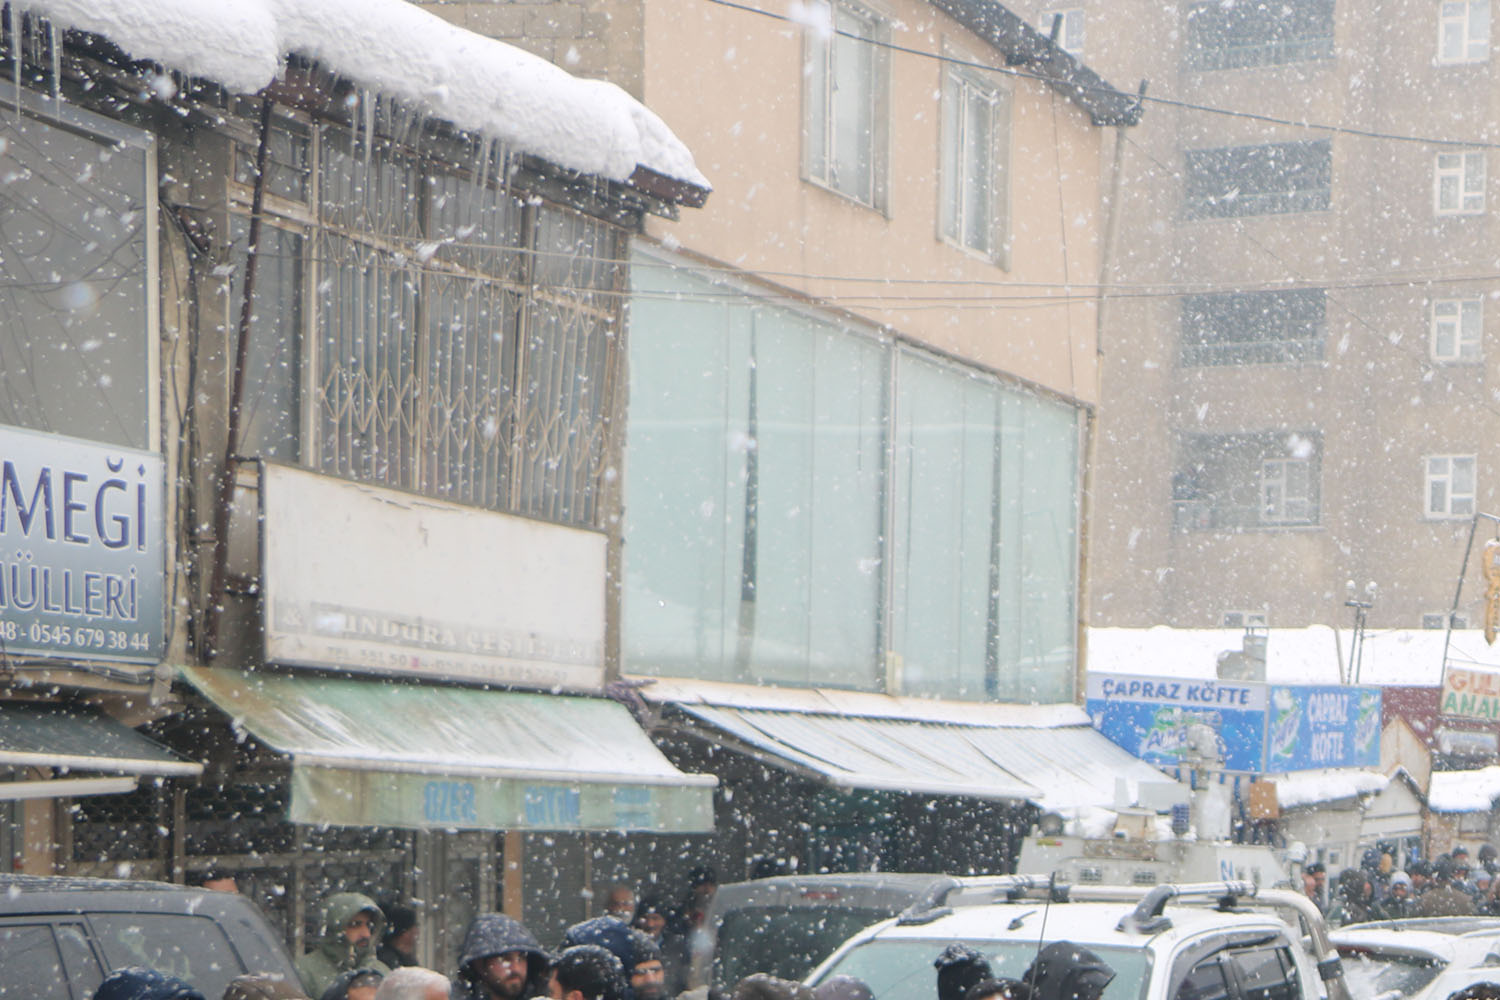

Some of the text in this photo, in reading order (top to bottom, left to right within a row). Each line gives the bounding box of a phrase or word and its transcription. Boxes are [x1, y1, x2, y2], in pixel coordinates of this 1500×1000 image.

[0, 456, 147, 553] MEĞİ
[0, 550, 138, 621] ÜLLERİ
[30, 623, 72, 645] 0545
[75, 627, 105, 648] 679
[108, 630, 128, 650] 38
[130, 632, 150, 651] 44
[1102, 678, 1251, 706] ÇAPRAZ KÖFTE
